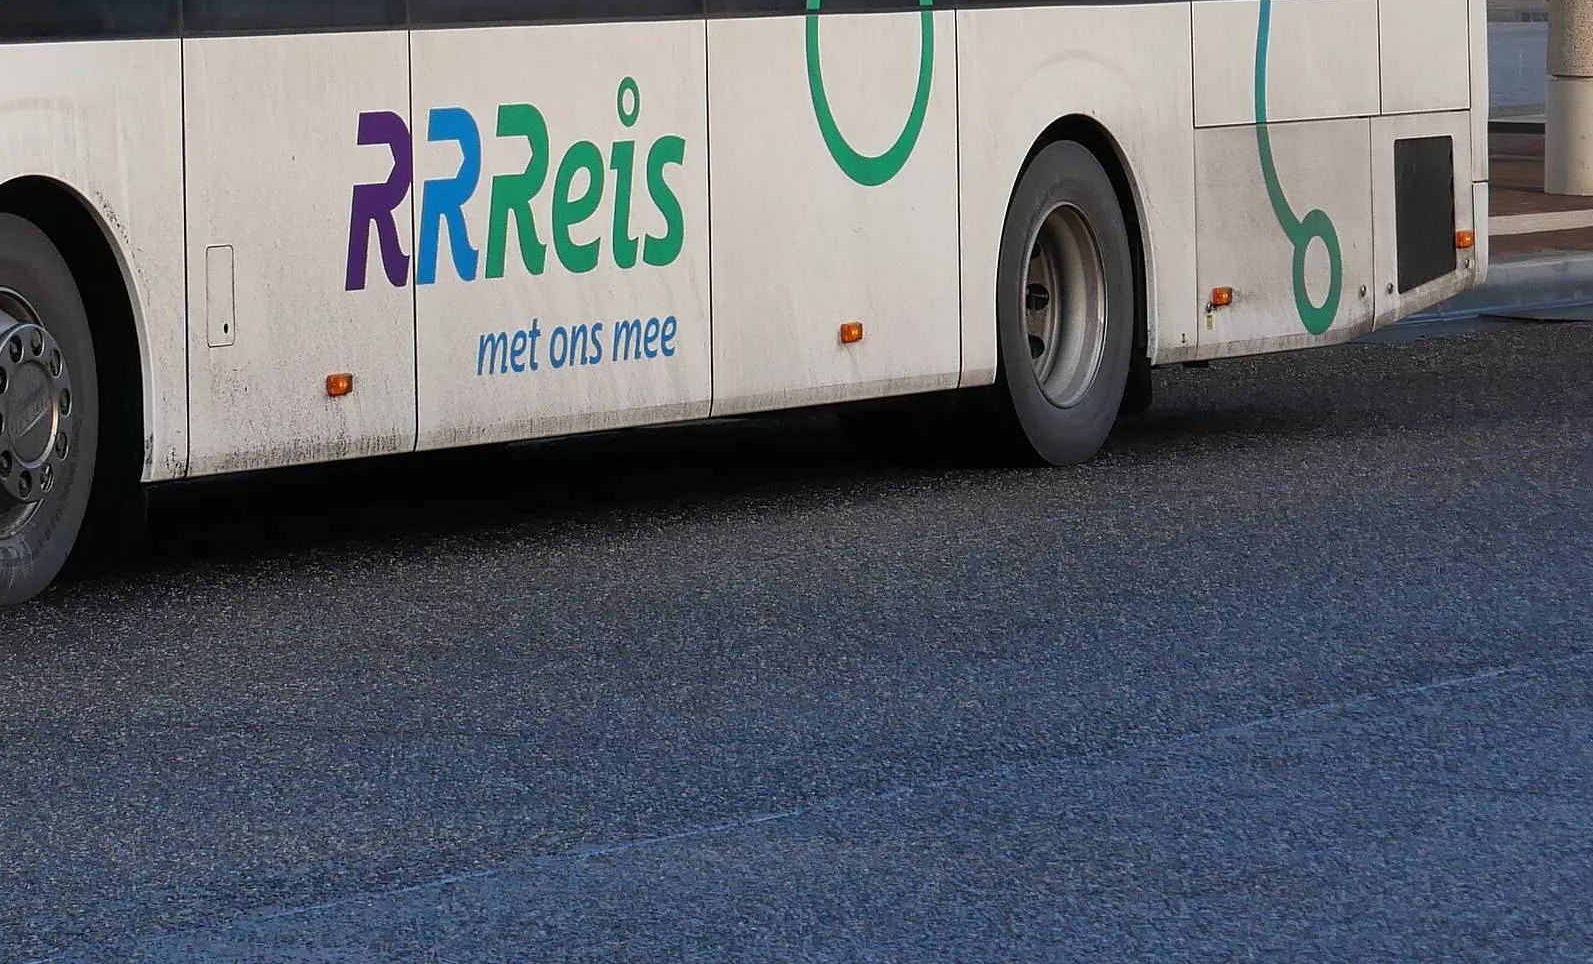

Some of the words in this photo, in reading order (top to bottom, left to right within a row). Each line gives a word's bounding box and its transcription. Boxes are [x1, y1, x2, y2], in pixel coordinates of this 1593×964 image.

[345, 76, 686, 292] RRReis
[477, 318, 541, 376] met
[549, 321, 603, 369] ons
[612, 315, 678, 362] mee
